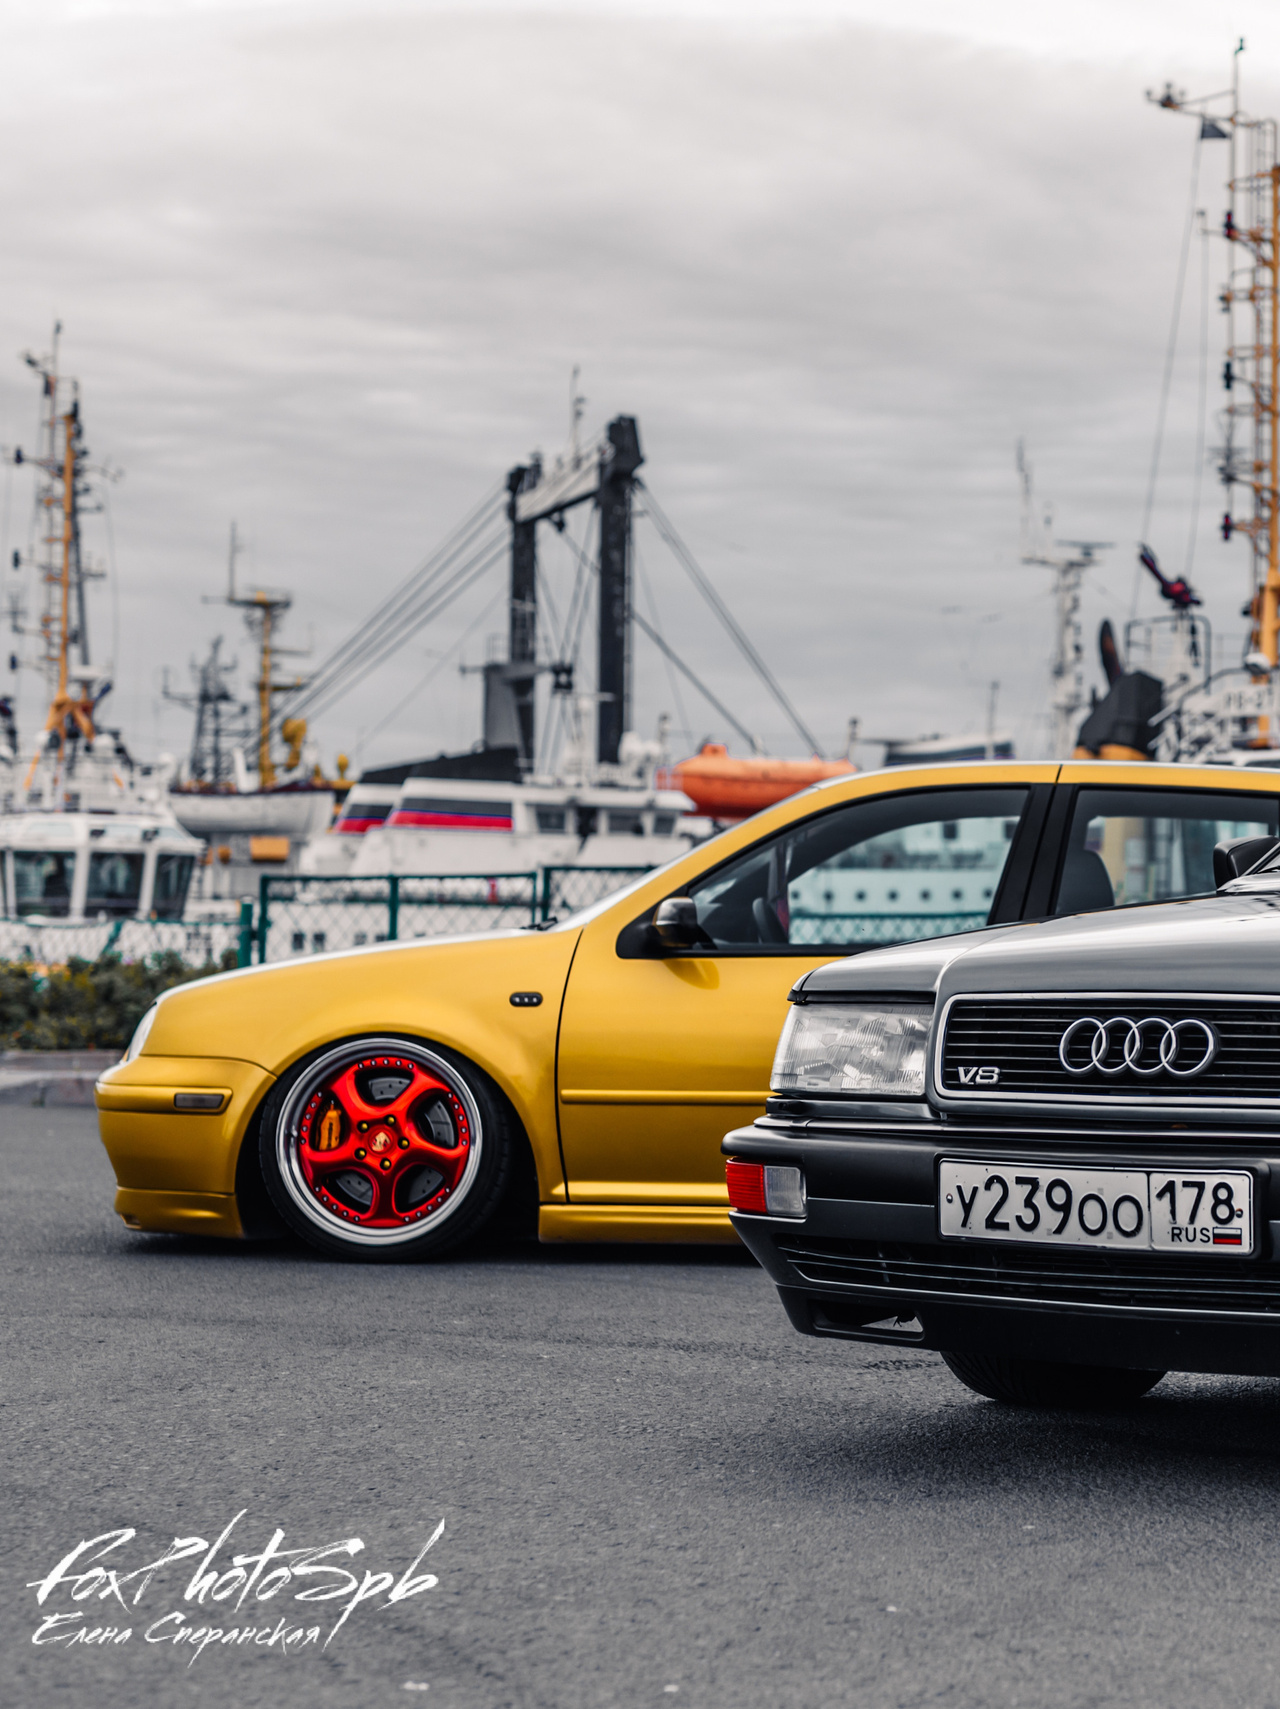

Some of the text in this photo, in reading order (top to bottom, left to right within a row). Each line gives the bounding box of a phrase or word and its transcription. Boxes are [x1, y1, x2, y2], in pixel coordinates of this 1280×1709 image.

[957, 1066, 1000, 1085] V8
[1156, 1179, 1236, 1225] 178
[1171, 1226, 1211, 1243] RUS
